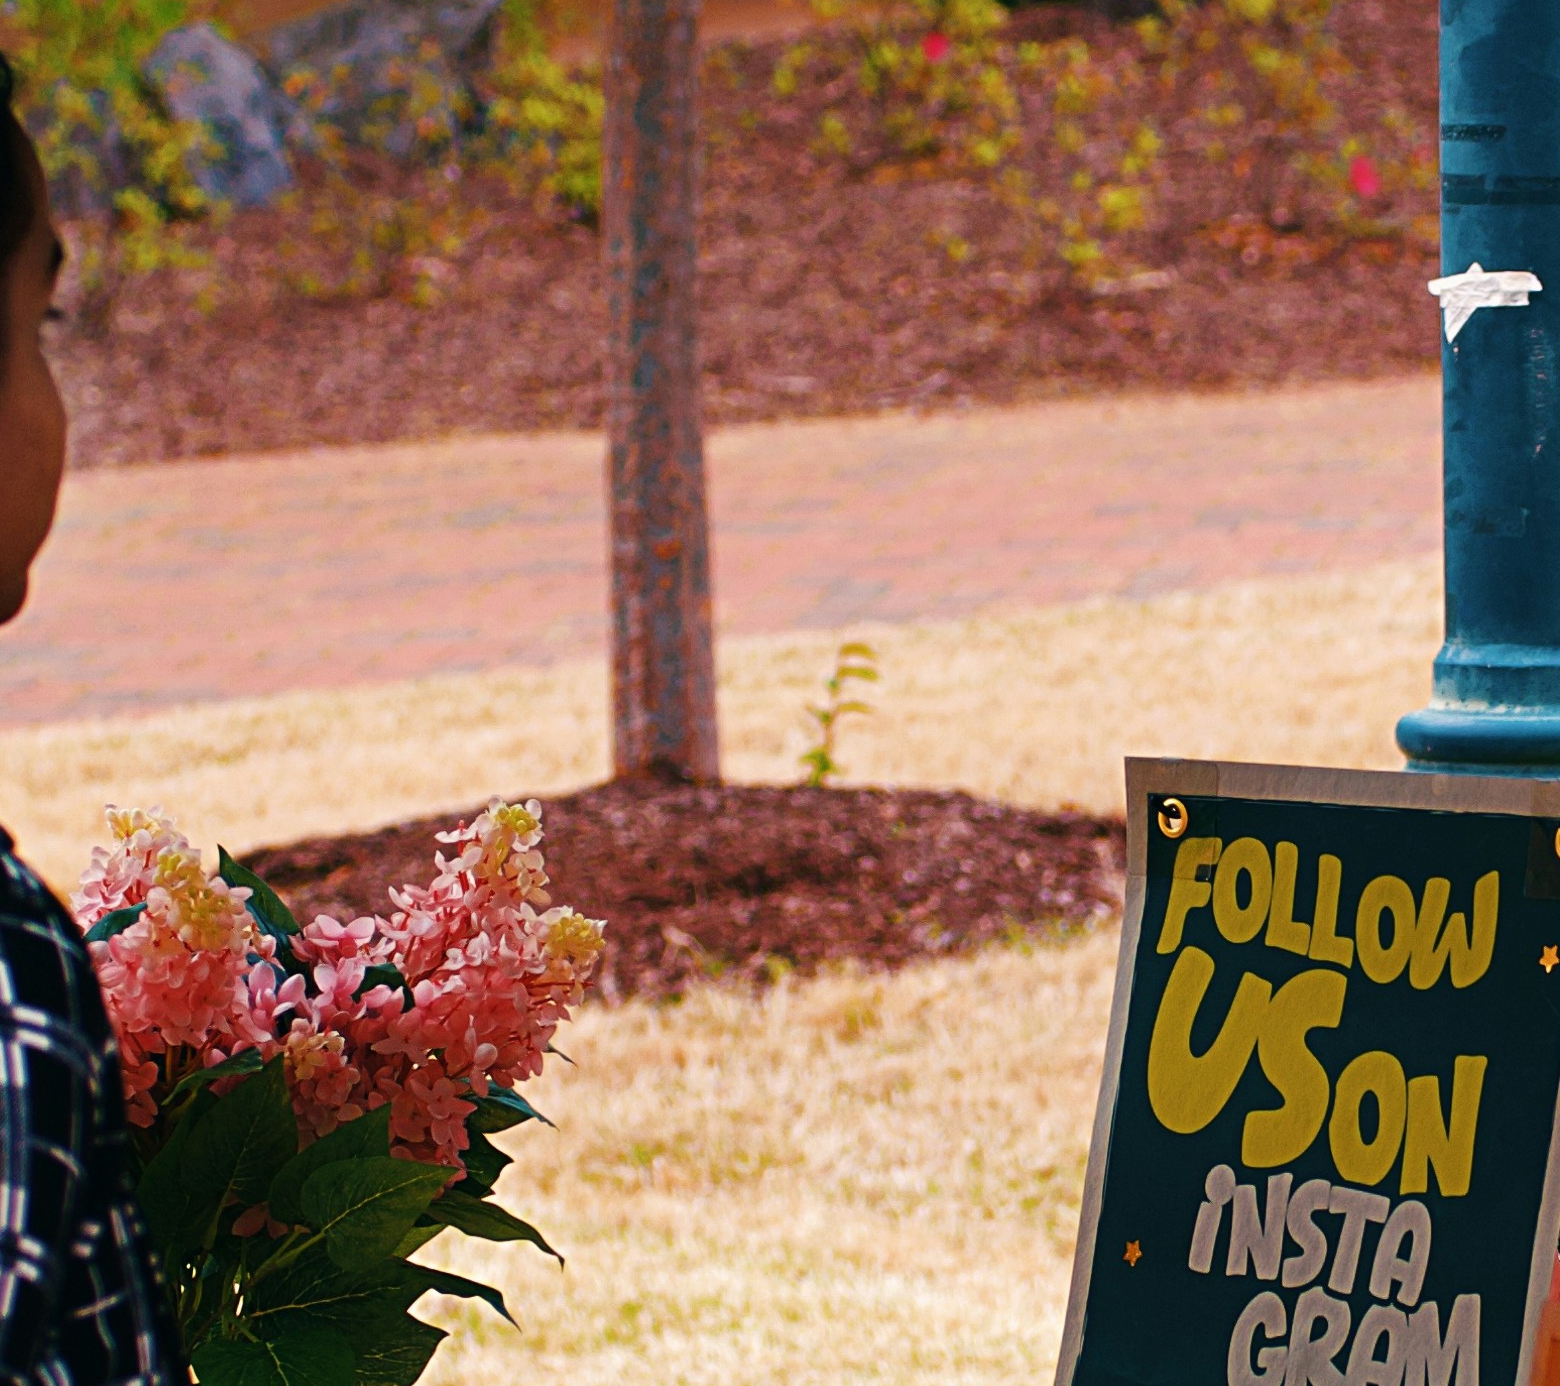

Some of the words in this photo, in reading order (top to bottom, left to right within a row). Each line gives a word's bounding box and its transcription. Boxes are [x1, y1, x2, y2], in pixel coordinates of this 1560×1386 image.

[1156, 836, 1500, 990] FOLLOW
[1147, 946, 1348, 1169] US
[1328, 1050, 1488, 1197] ON
